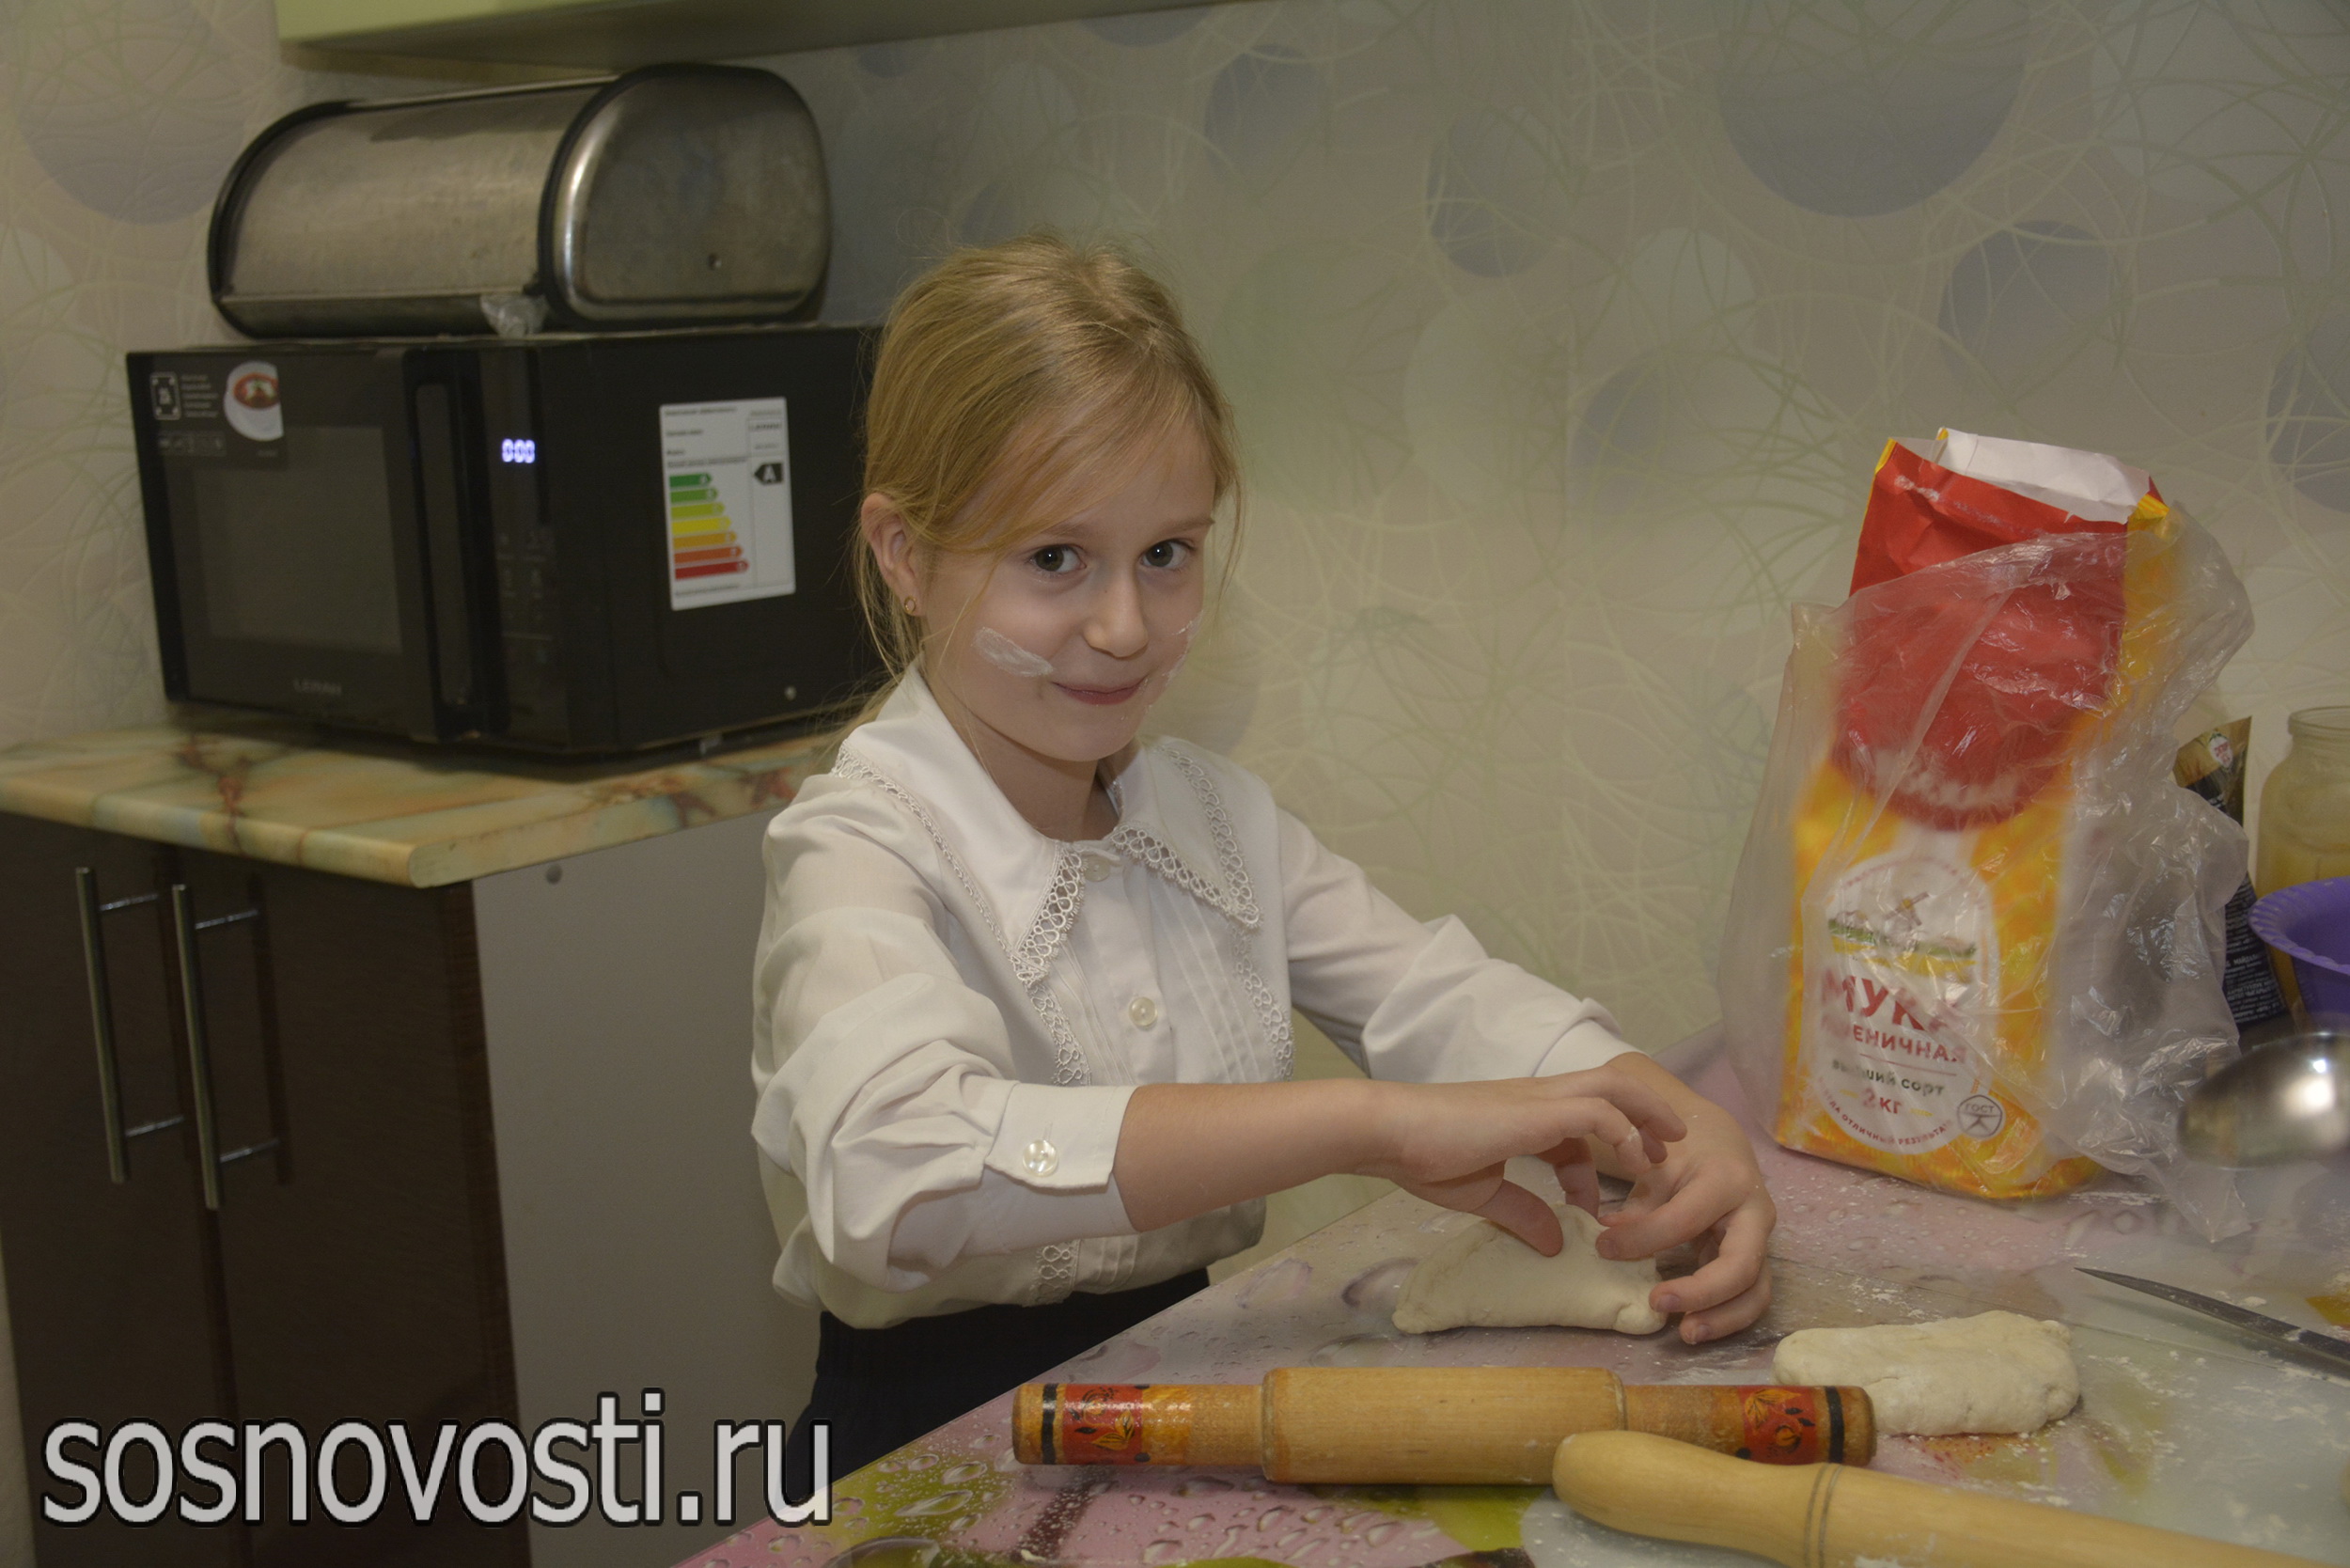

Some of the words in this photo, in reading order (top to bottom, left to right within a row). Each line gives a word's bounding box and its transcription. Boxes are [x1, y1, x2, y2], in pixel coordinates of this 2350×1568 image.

[761, 464, 776, 481] A
[1821, 969, 1958, 1033] МУК
[1821, 1013, 1966, 1064] ЕНИЧНАЯ
[1965, 1098, 1995, 1113] ГОСТ
